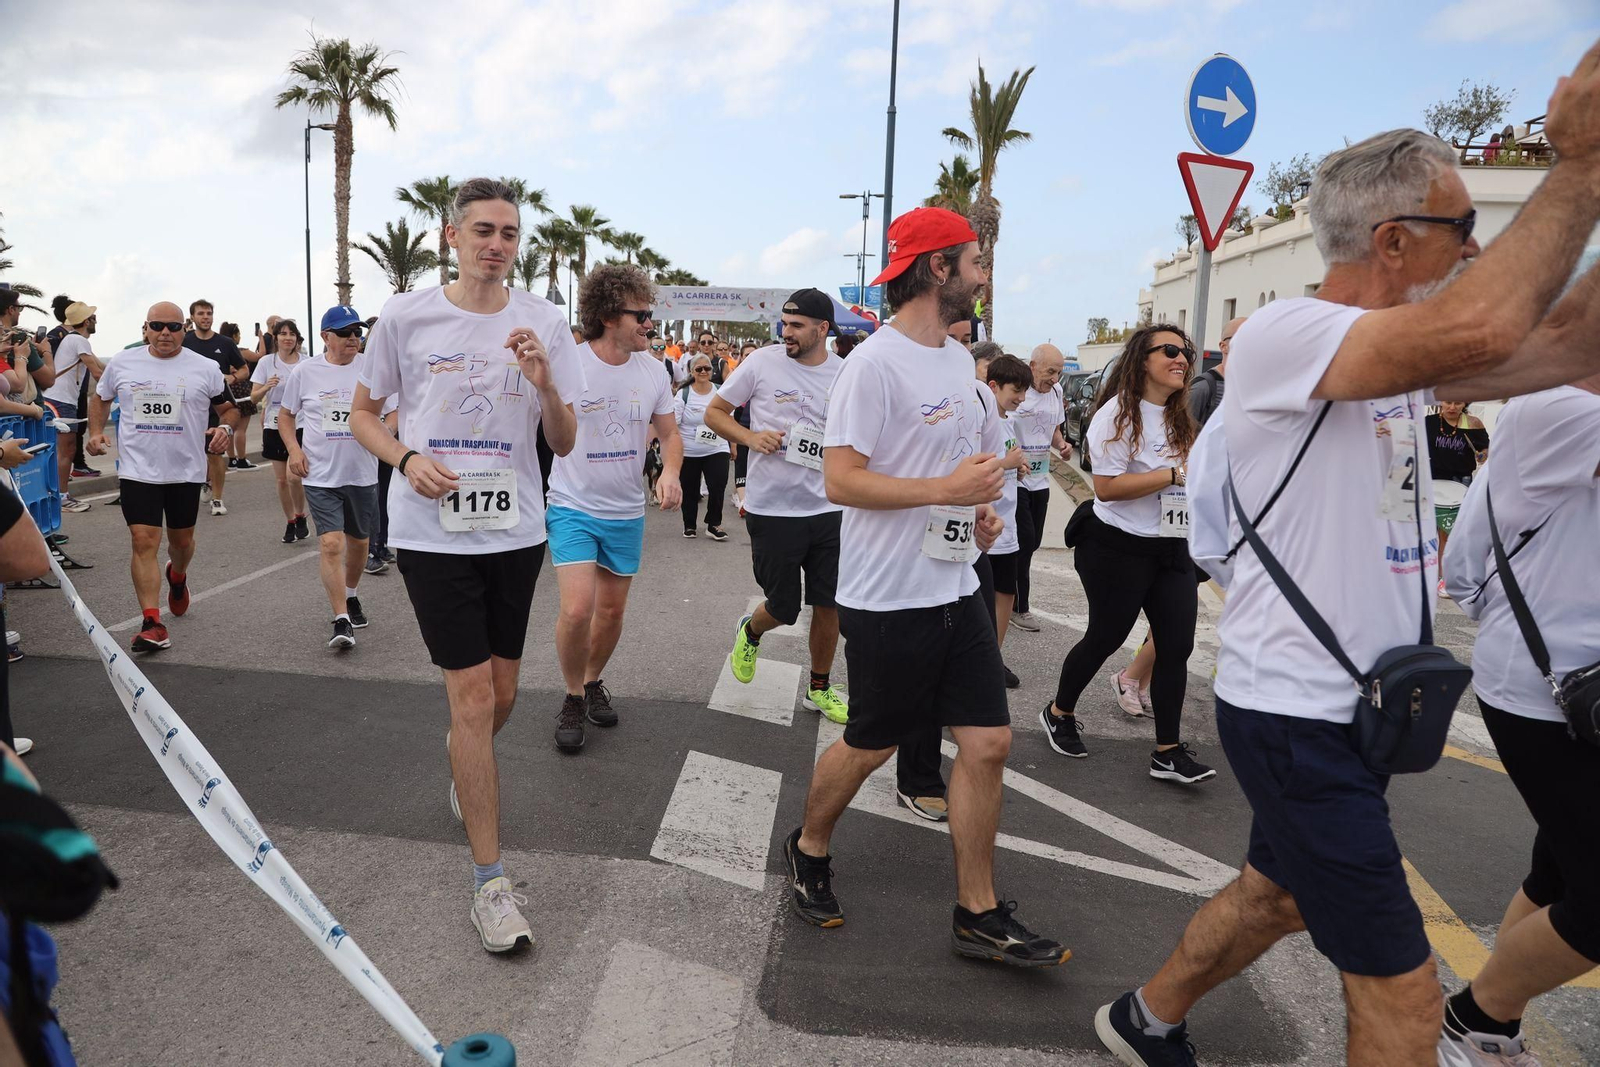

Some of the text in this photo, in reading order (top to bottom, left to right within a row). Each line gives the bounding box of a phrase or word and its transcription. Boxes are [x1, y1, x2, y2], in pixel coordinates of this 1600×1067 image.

[685, 292, 728, 300] CARRERA
[142, 403, 172, 415] 380
[331, 410, 350, 423] 37
[700, 430, 717, 440] 228
[428, 438, 460, 448] DONACIÓN
[461, 439, 500, 449] TRASPLANTE
[1030, 460, 1042, 471] 32
[446, 490, 511, 513] 1178
